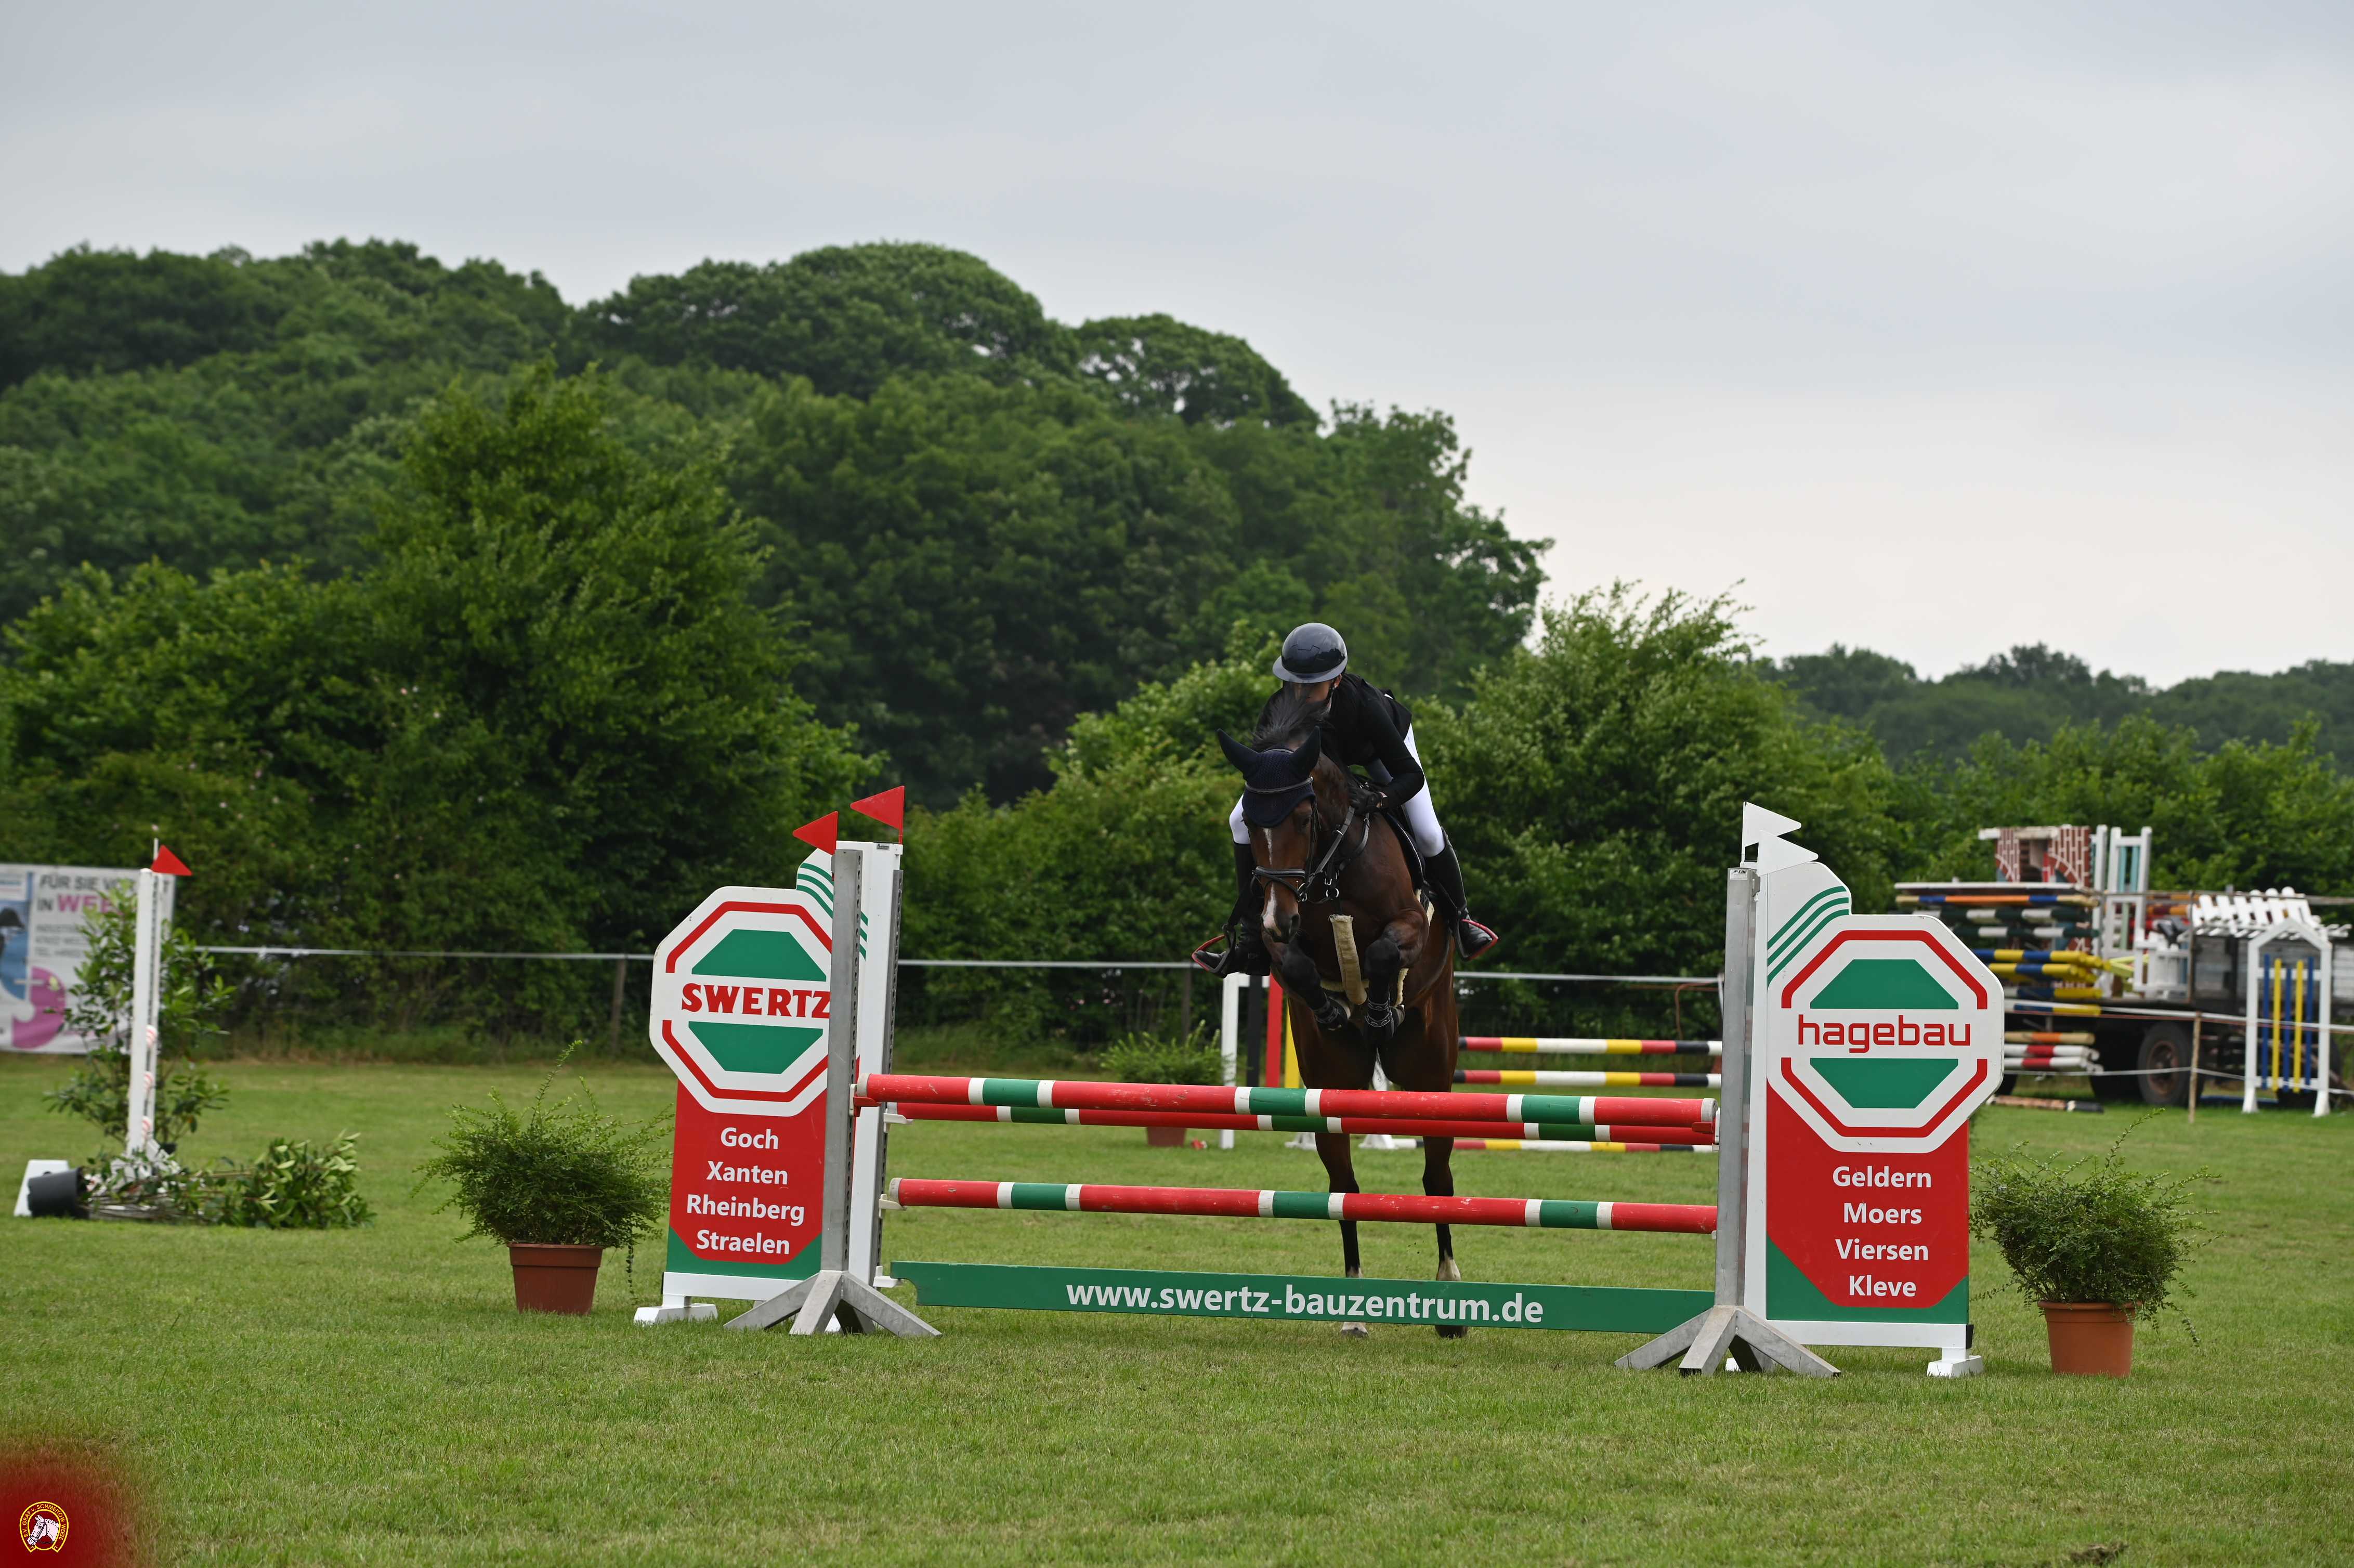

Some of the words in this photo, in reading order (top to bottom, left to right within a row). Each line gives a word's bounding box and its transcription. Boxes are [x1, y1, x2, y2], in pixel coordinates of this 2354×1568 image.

[39, 873, 70, 889] FÜR
[75, 876, 98, 891] SIE
[37, 898, 53, 911] IN
[682, 983, 831, 1019] SWERTZ
[1798, 1014, 1970, 1053] hagebau
[721, 1127, 779, 1150] Goch
[706, 1160, 788, 1185] Xanten
[1833, 1166, 1932, 1188] Geldern
[687, 1194, 805, 1226] Rheinberg
[1843, 1203, 1922, 1224] Moers
[696, 1230, 790, 1255] Straelen
[1835, 1238, 1929, 1261] Viersen
[1849, 1274, 1917, 1297] Kleve
[1066, 1284, 1544, 1323] www.swertz-bauzentrum.de
